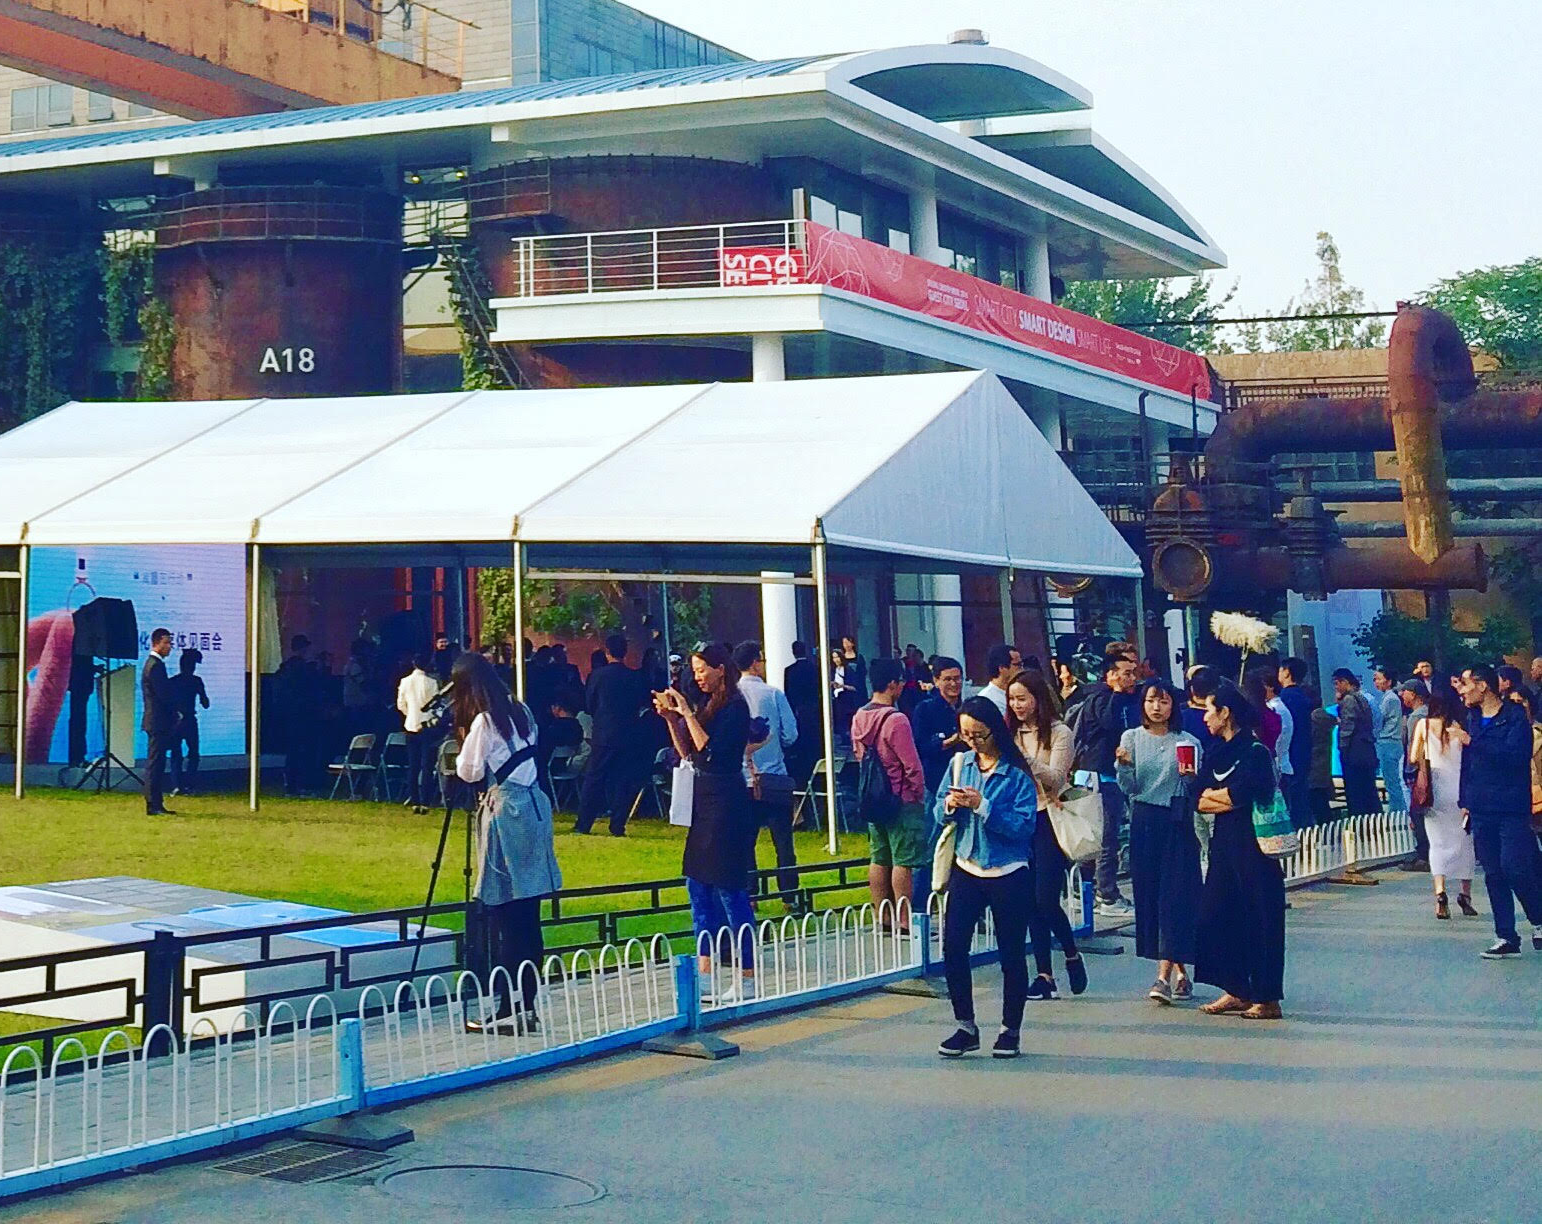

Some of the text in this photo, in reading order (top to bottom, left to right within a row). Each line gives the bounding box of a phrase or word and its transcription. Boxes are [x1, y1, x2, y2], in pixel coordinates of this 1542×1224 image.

[749, 255, 773, 285] CI
[1019, 309, 1047, 336] SMART
[1048, 319, 1076, 345] DESIGN
[259, 347, 315, 373] A18
